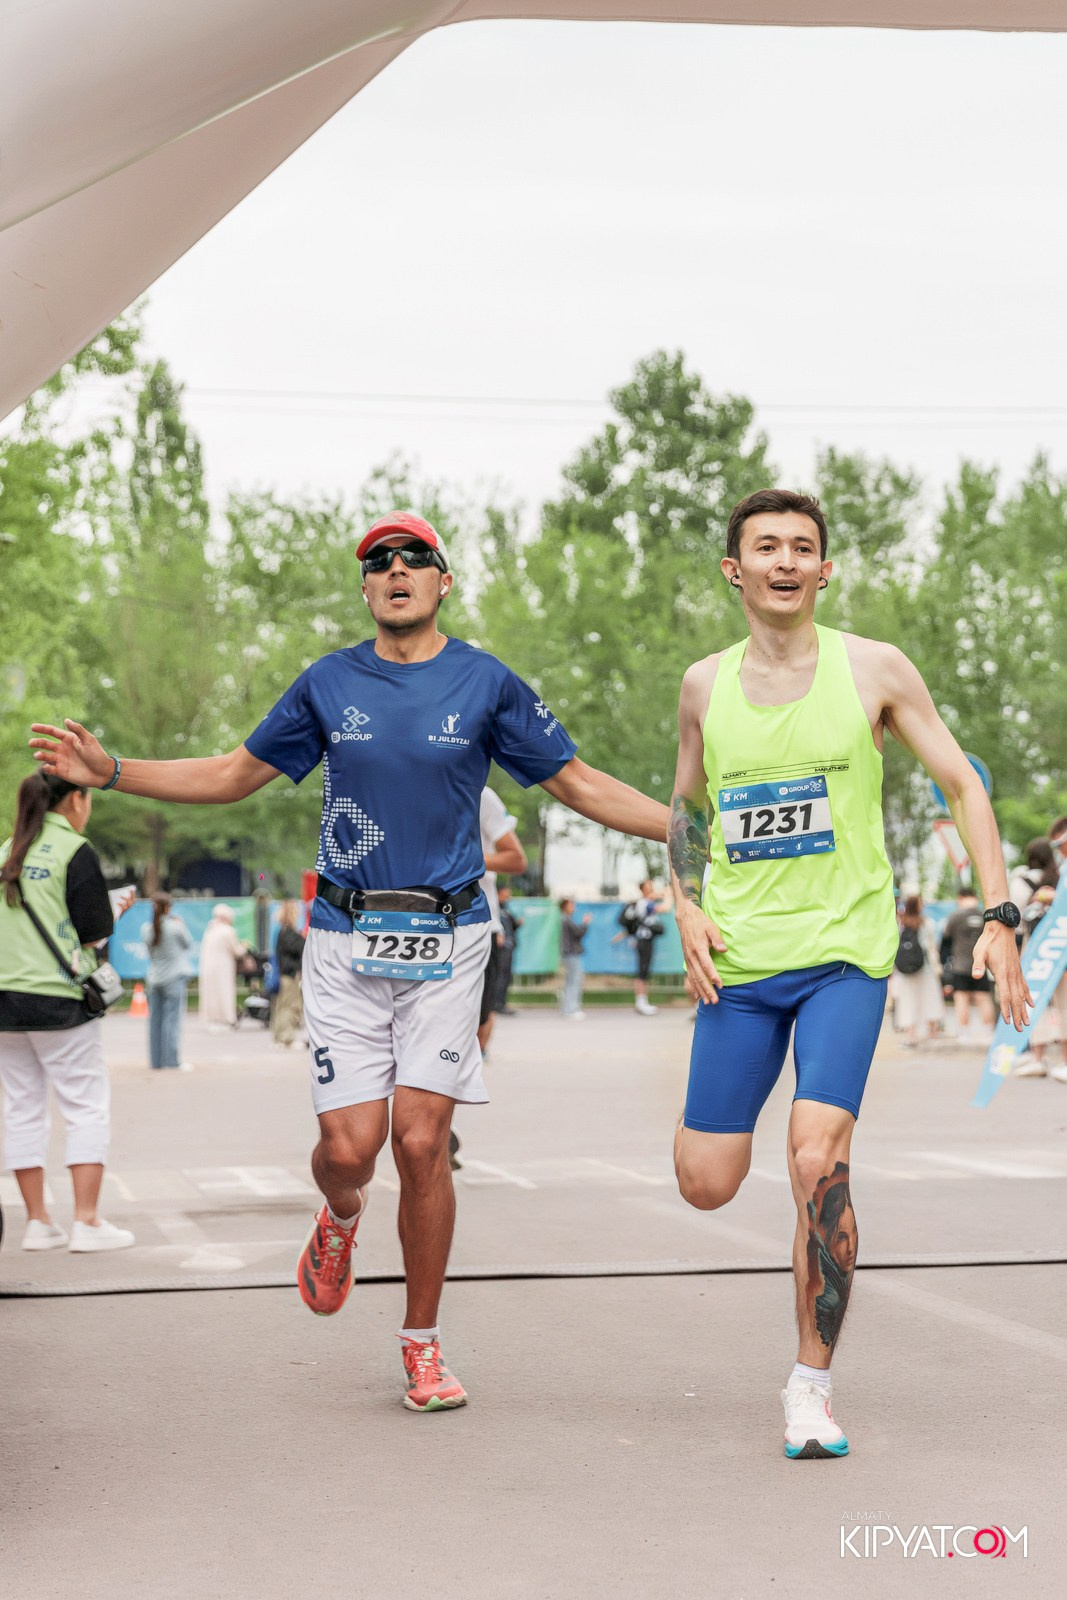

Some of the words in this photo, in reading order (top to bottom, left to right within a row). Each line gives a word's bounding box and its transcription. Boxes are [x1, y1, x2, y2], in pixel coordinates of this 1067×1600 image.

[341, 733, 373, 741] GROUP
[788, 784, 811, 793] GROUP
[722, 792, 732, 803] 5
[733, 792, 748, 802] KM
[739, 802, 813, 839] 1231
[367, 916, 382, 925] KM
[366, 934, 441, 961] 1238
[314, 1046, 335, 1085] 5
